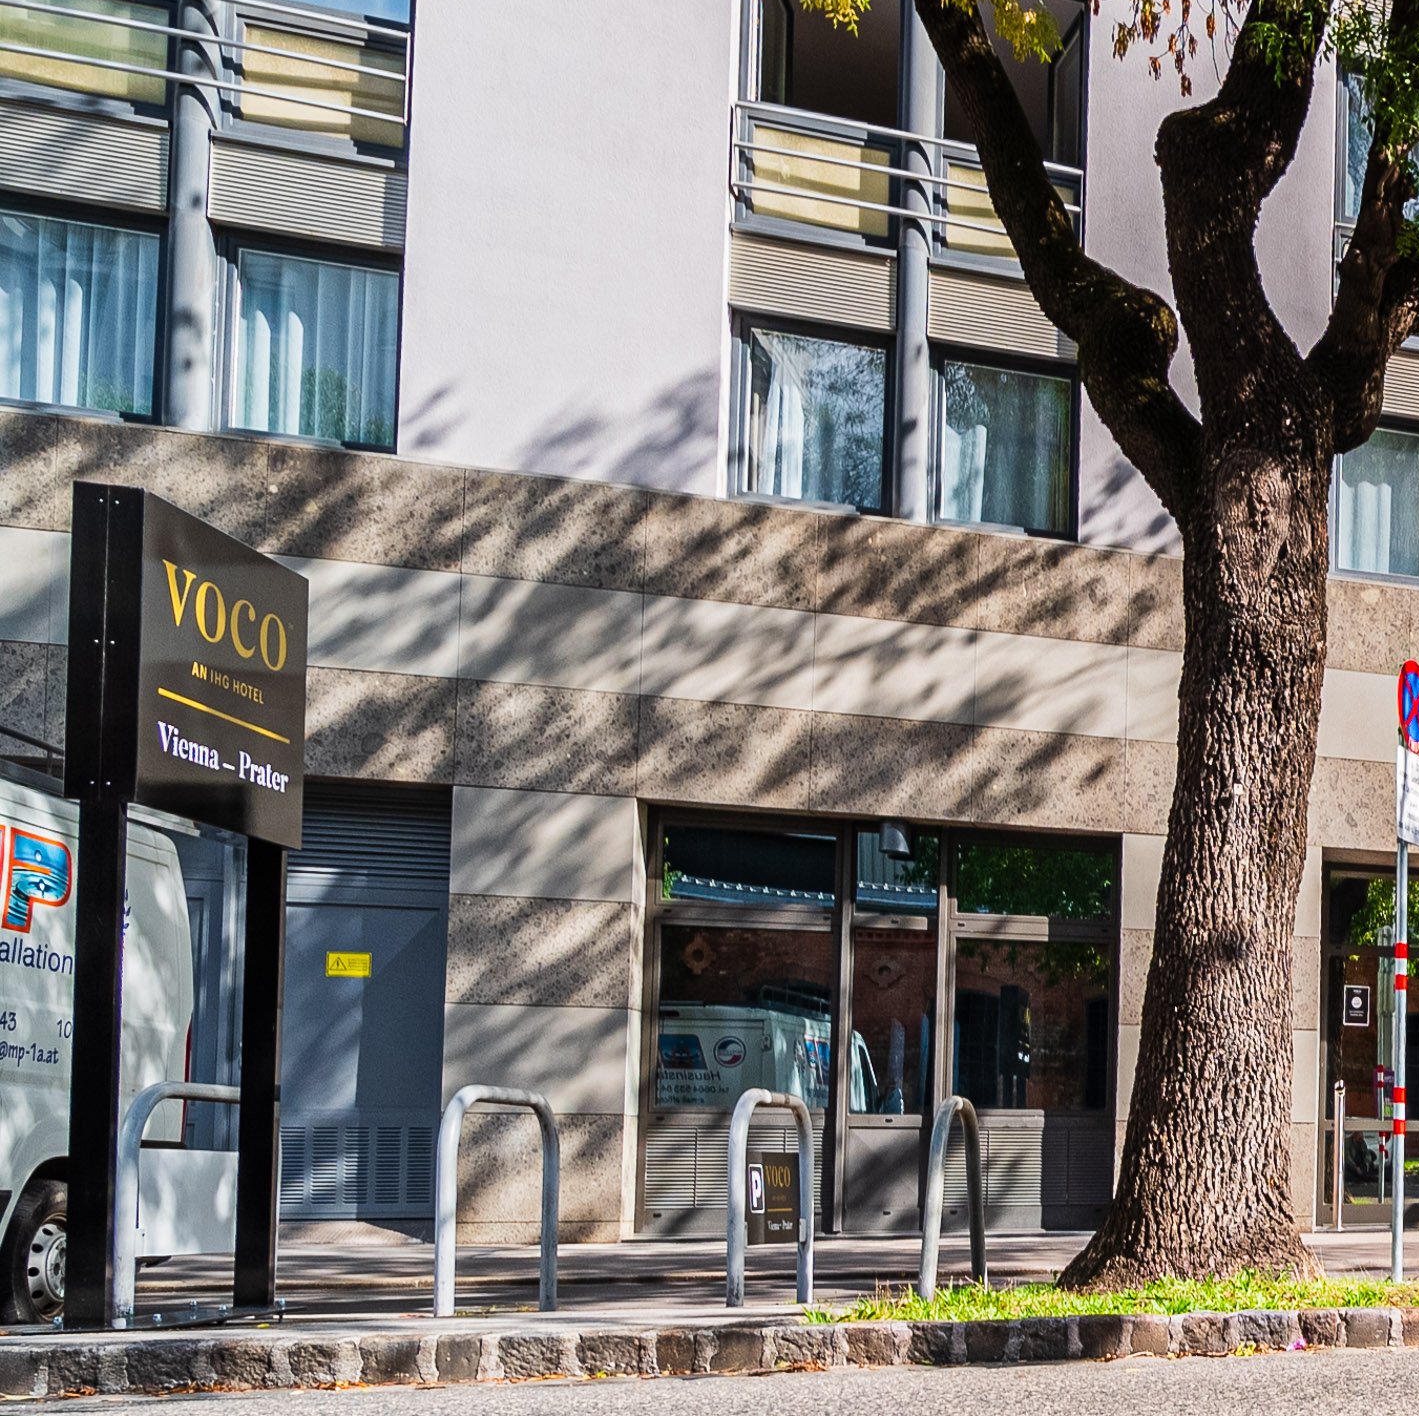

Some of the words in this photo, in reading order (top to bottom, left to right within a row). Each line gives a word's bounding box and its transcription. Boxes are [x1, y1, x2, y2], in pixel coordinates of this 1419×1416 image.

[191, 661, 207, 680] AN
[210, 669, 230, 689] IHG
[232, 678, 264, 705] HOTEL
[157, 720, 220, 771] Vienna
[238, 750, 289, 793] Prater
[751, 1170, 762, 1208] P
